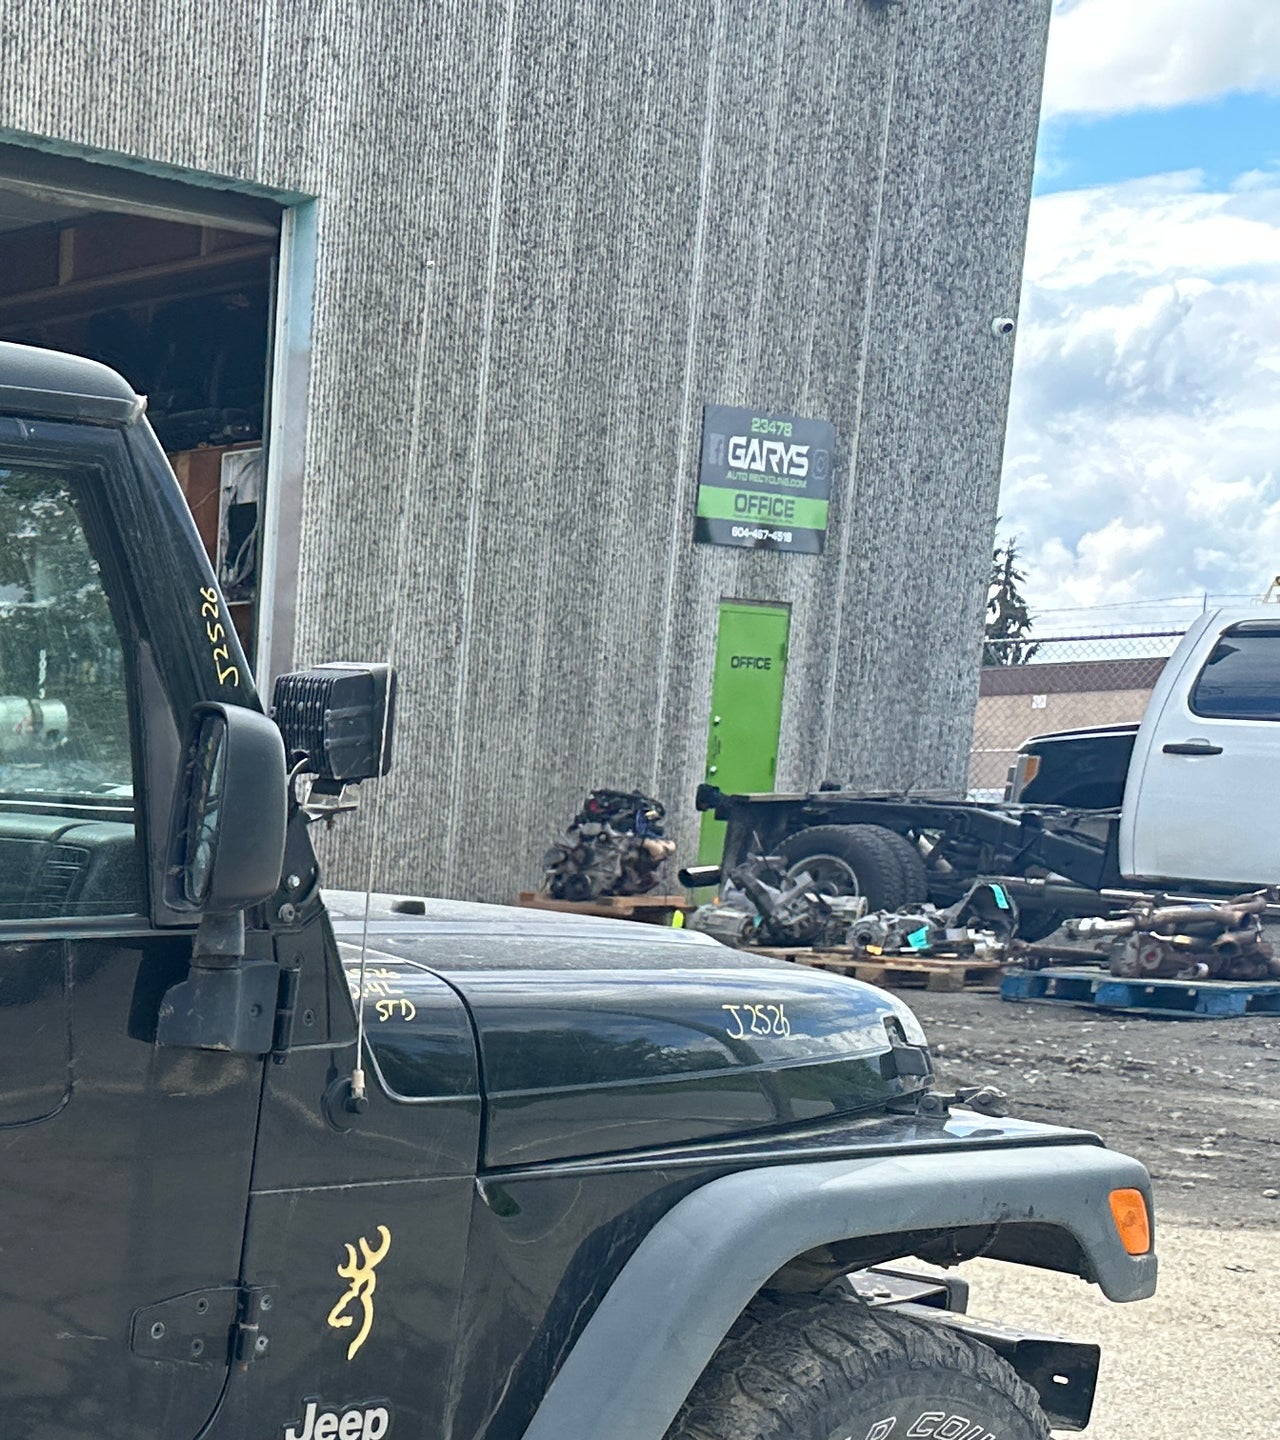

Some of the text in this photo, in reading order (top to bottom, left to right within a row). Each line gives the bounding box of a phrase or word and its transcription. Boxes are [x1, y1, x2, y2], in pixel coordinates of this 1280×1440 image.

[751, 417, 793, 437] 23478
[728, 436, 810, 477] GARYS
[734, 493, 796, 518] OFFICE
[200, 586, 239, 687] J2526
[730, 655, 772, 670] OFFICE
[375, 998, 417, 1022] STD
[722, 1004, 791, 1040] J2526
